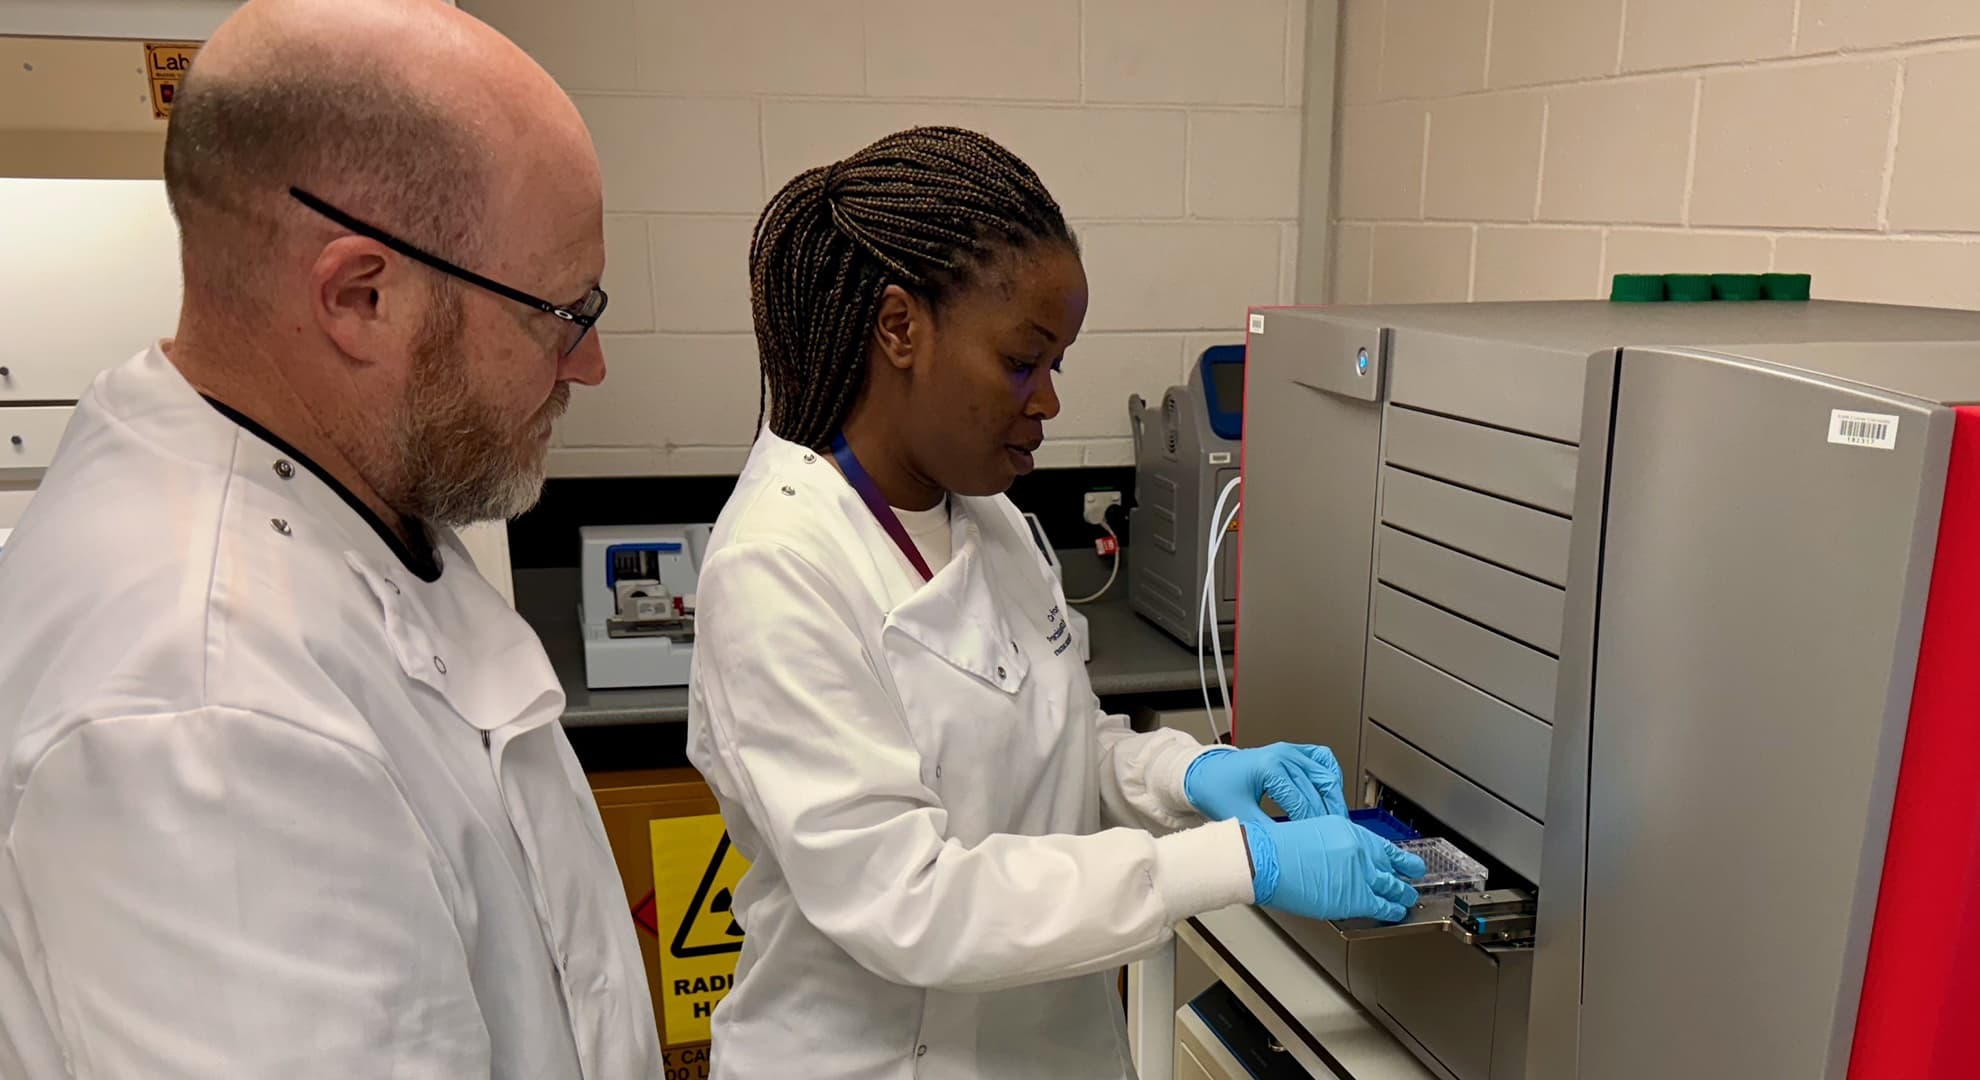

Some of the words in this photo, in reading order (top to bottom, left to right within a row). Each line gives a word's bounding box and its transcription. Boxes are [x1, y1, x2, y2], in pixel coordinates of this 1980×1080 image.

[153, 52, 190, 70] Lab
[674, 974, 734, 996] RADI
[693, 1000, 720, 1018] H
